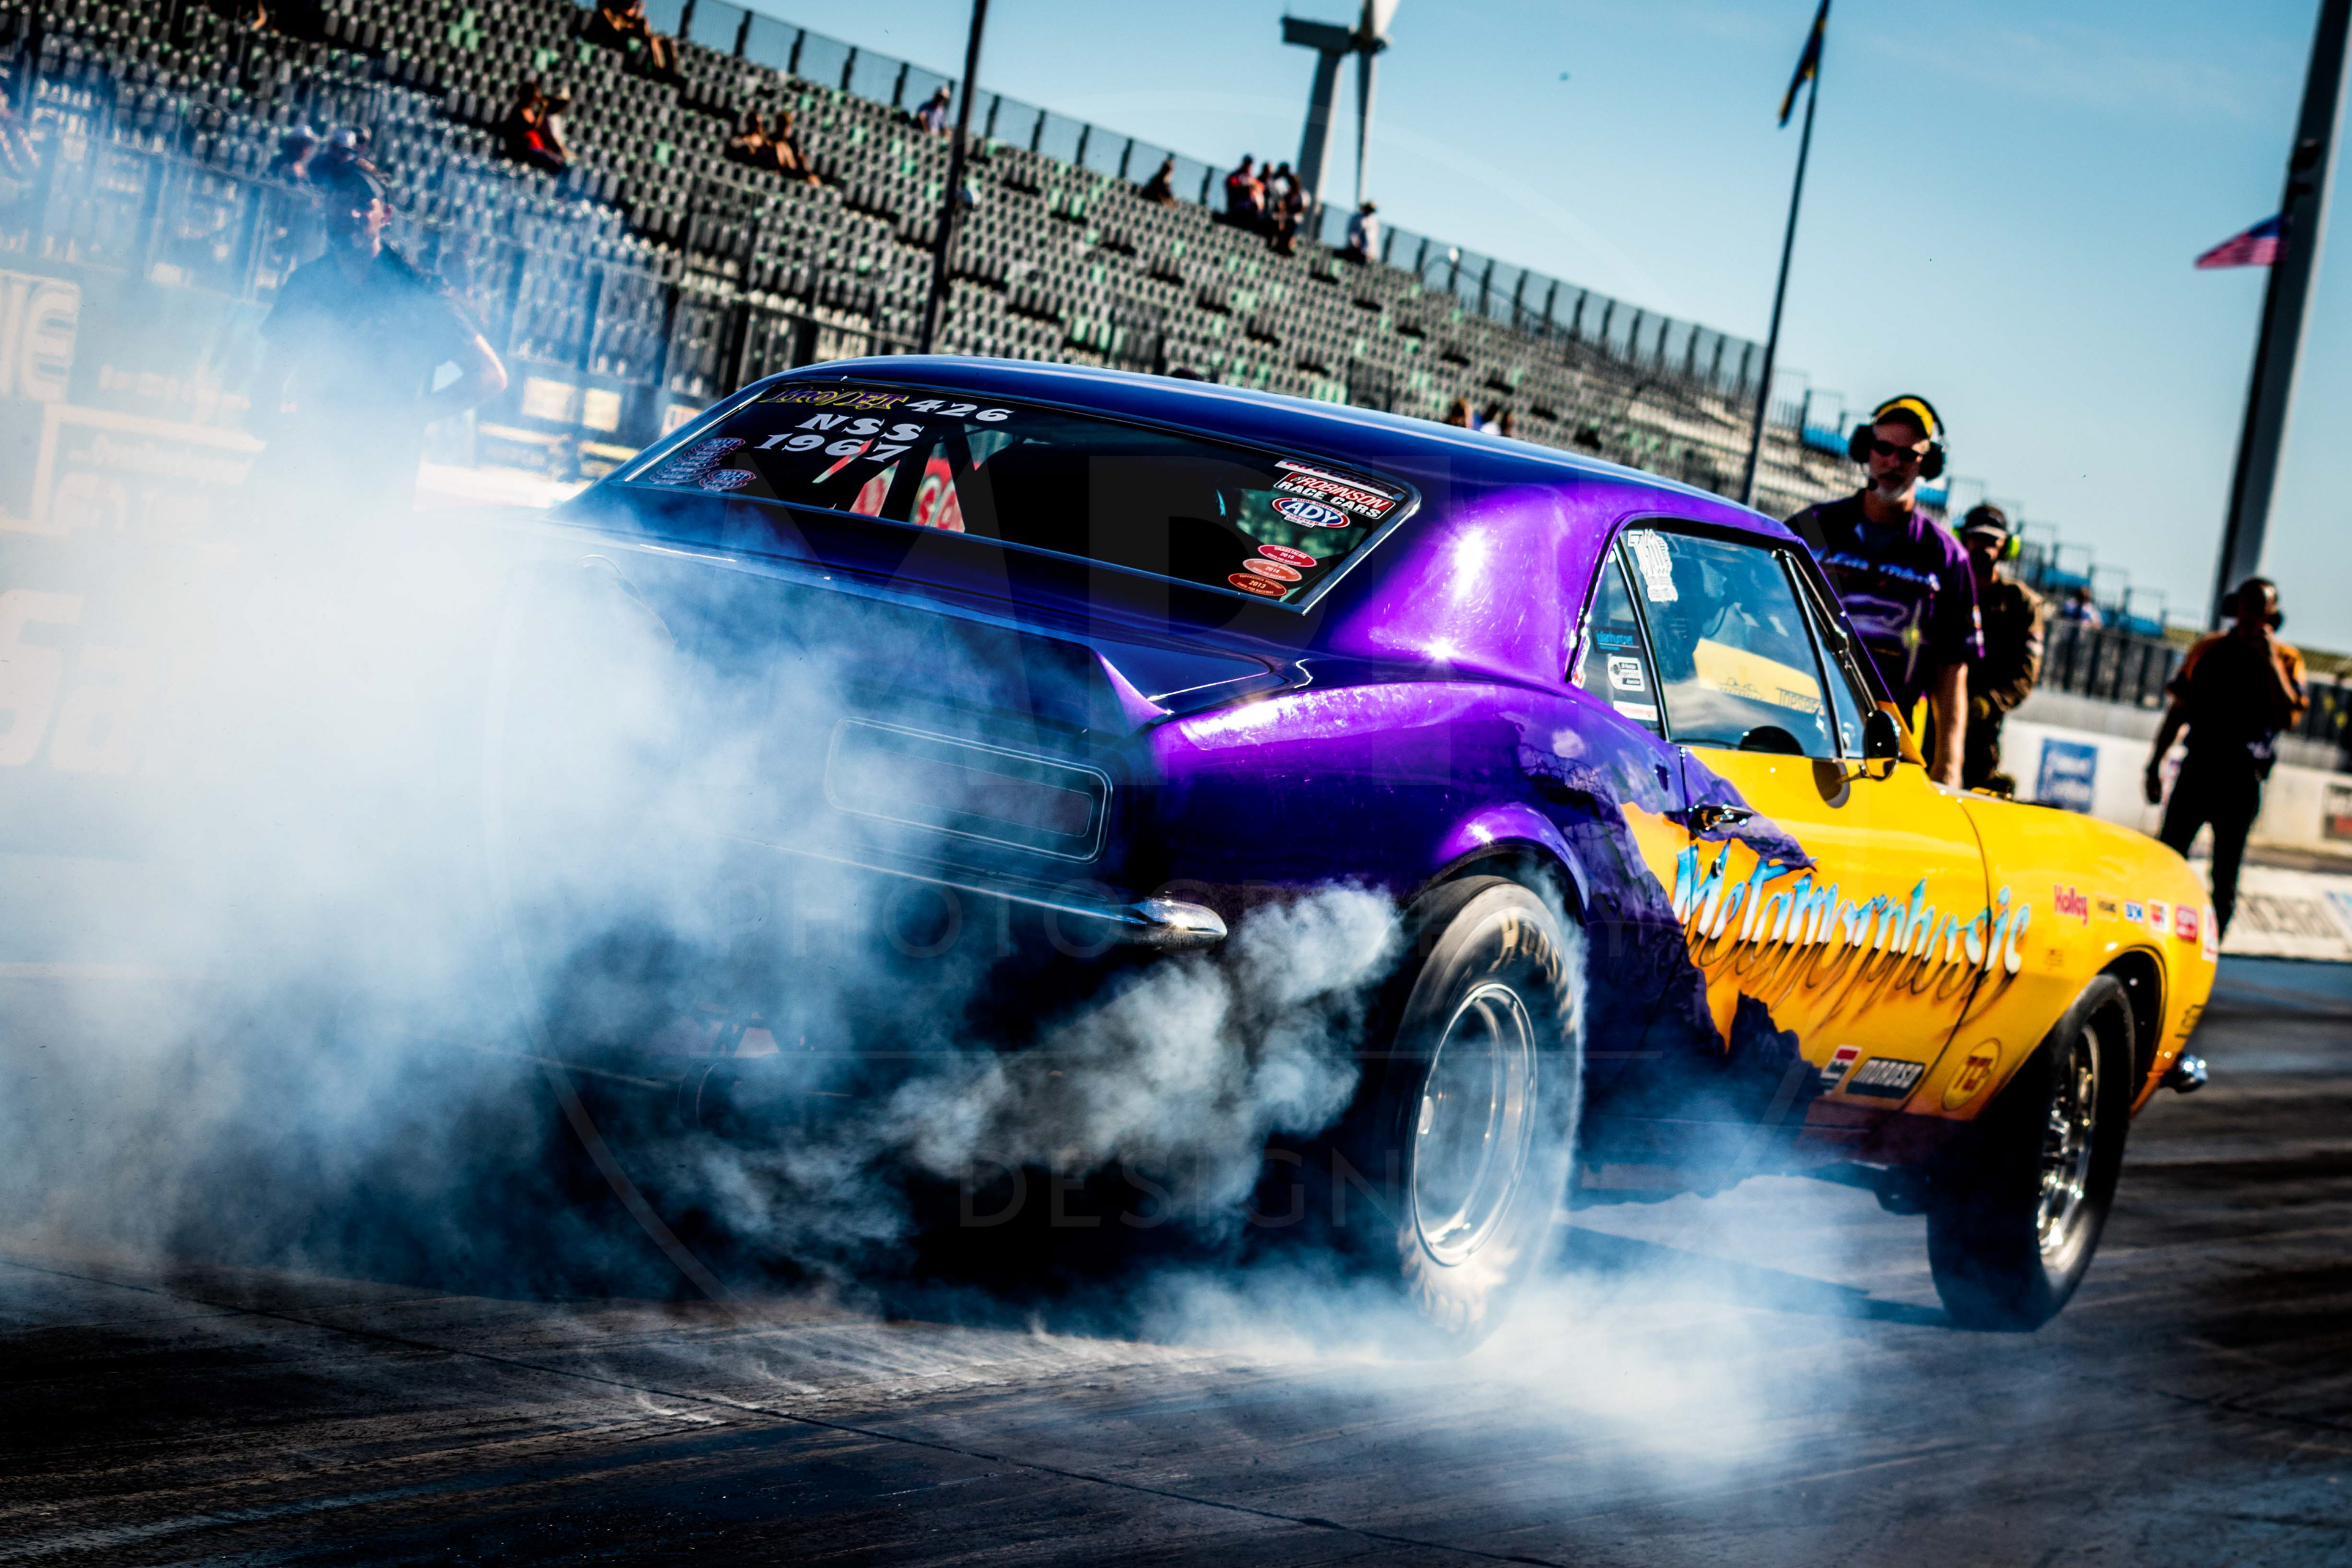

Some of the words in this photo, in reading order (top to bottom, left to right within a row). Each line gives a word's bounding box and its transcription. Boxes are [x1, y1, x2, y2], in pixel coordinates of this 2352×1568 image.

[904, 399, 1016, 422] 426
[794, 413, 925, 441] NSS
[753, 432, 913, 463] 1967
[1278, 481, 1328, 500] RACE
[1330, 496, 1381, 518] CARS
[1299, 476, 1390, 510] ROBINSON
[1284, 502, 1339, 523] ADY
[1314, 501, 1333, 510] WITH
[1285, 511, 1321, 526] FOREVER
[1248, 580, 1267, 589] 2013
